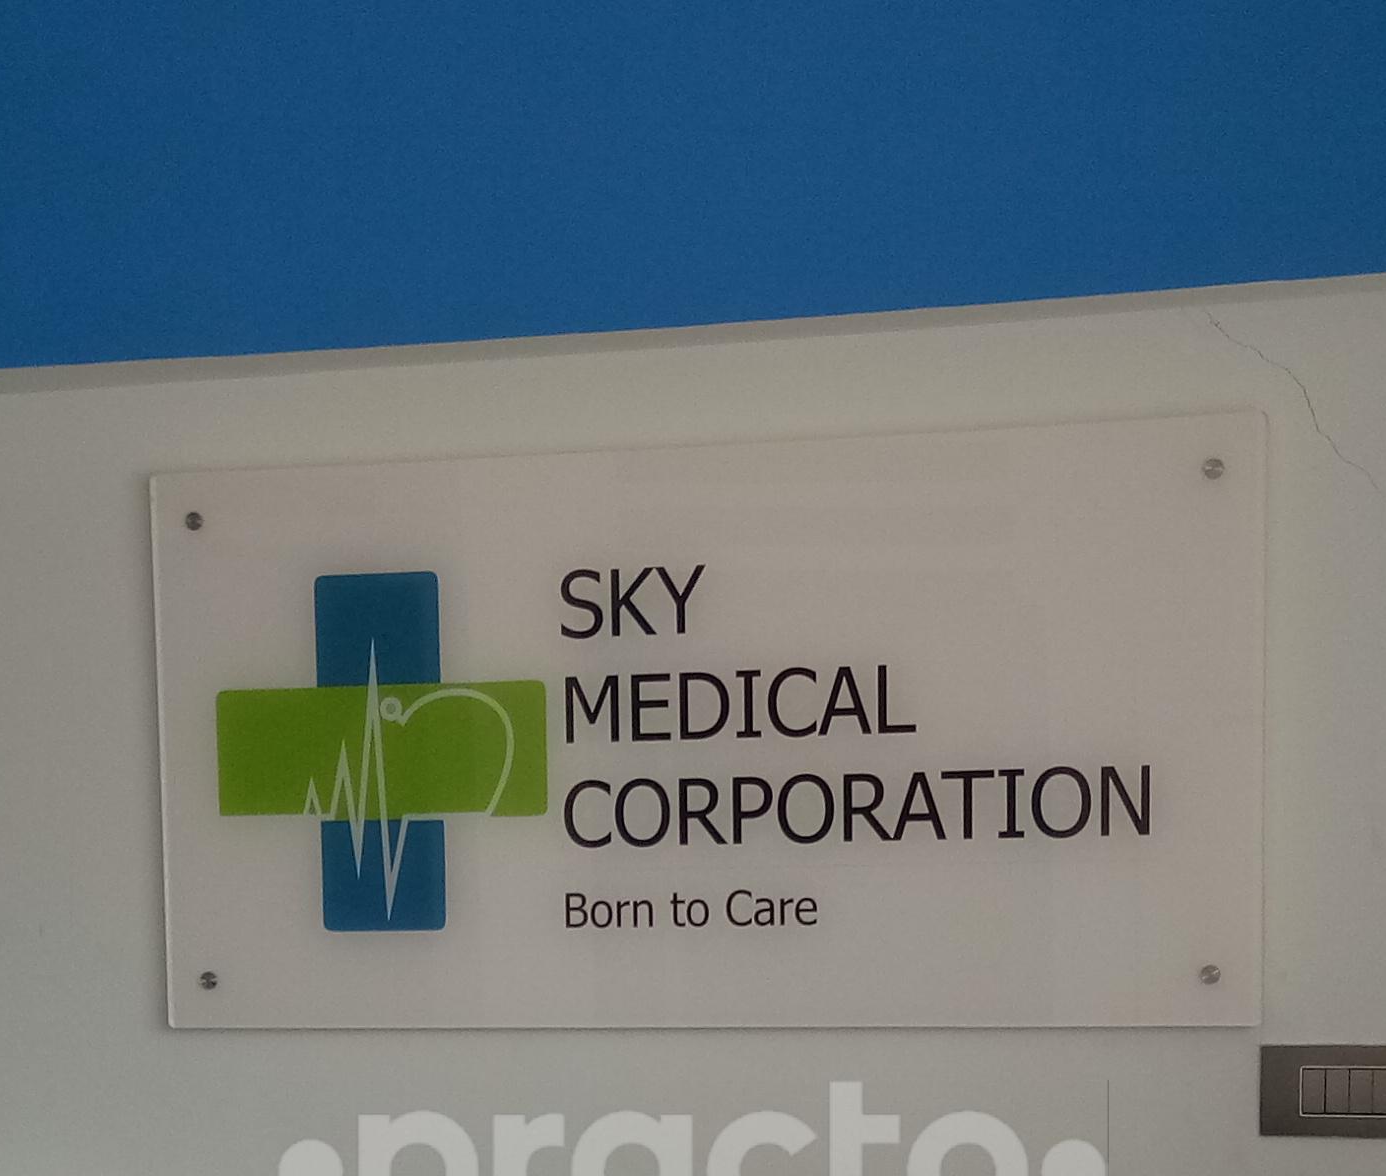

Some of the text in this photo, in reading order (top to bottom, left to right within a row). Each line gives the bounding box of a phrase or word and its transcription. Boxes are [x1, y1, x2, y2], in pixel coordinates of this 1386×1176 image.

[559, 564, 706, 639] SKY
[563, 664, 917, 744] MEDICAL
[563, 764, 1153, 847] CORPORATION
[563, 888, 819, 929] Born to Care
